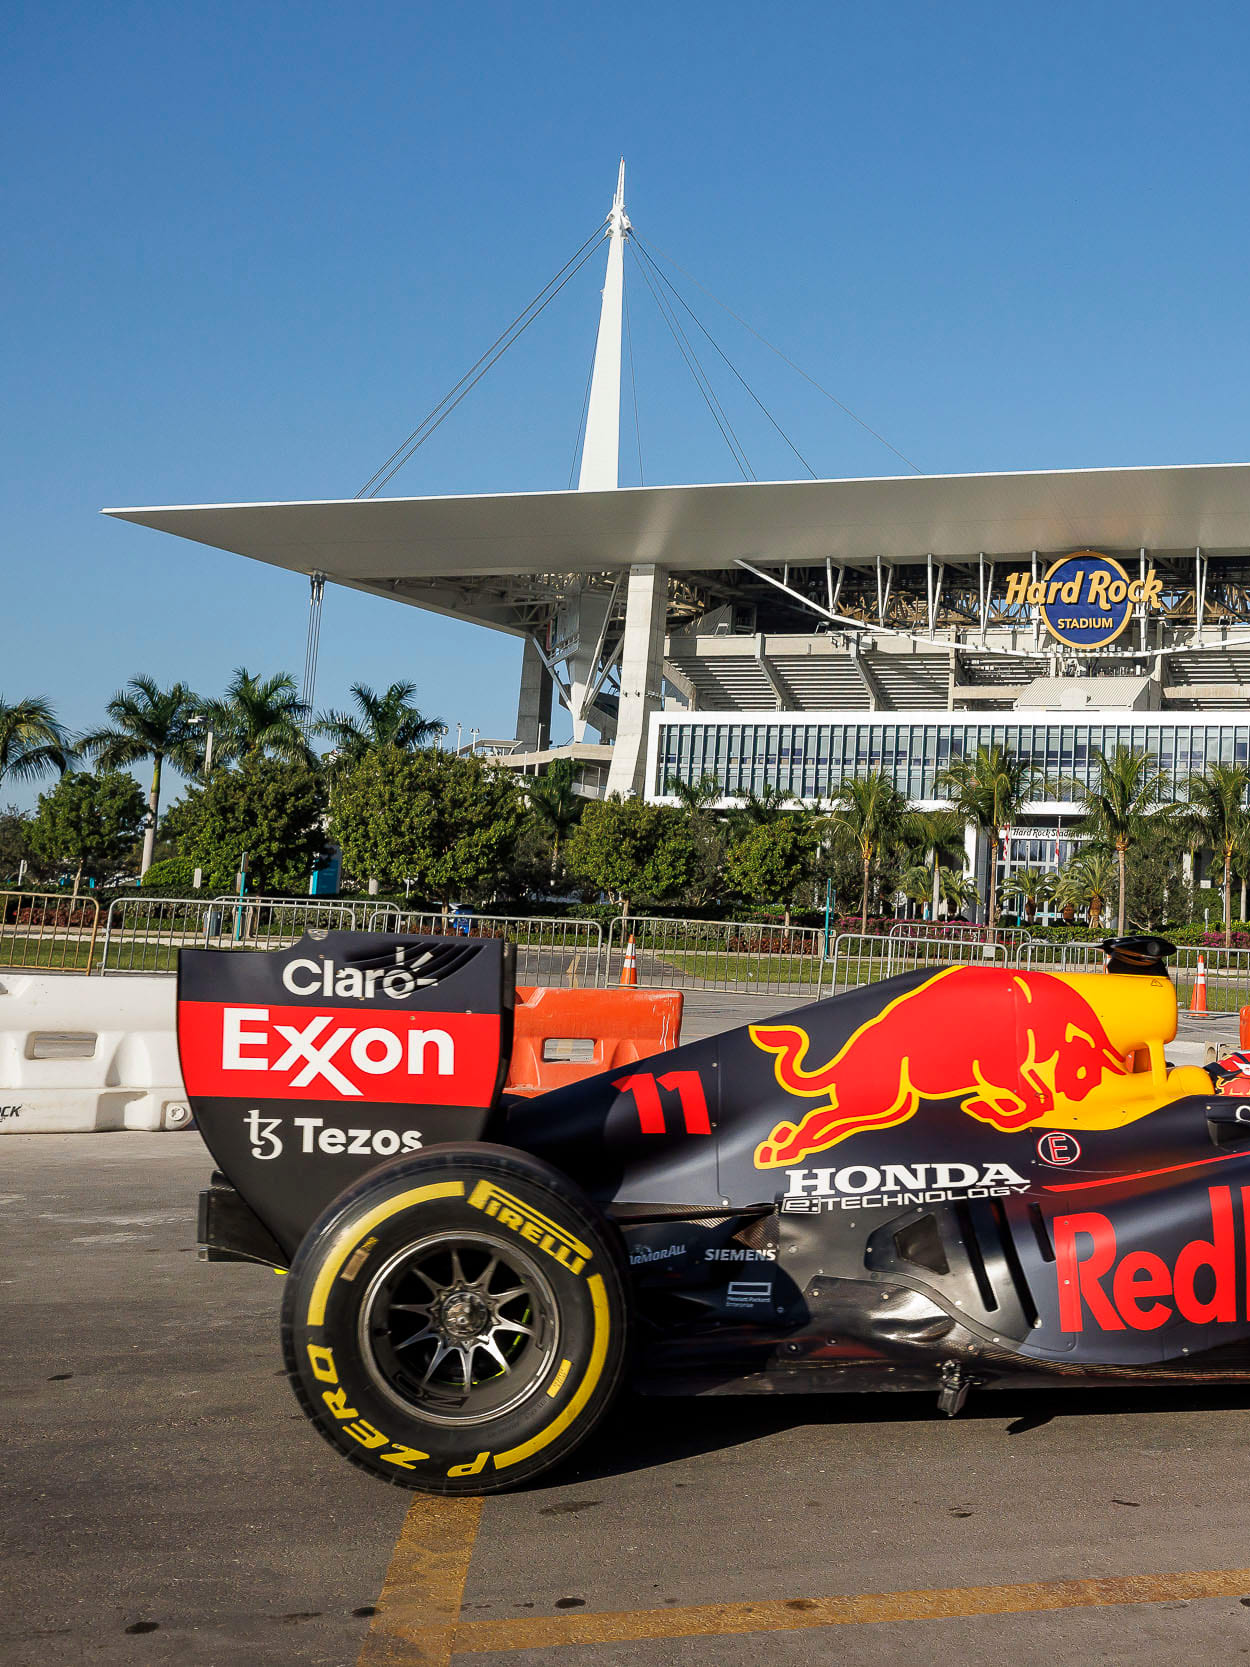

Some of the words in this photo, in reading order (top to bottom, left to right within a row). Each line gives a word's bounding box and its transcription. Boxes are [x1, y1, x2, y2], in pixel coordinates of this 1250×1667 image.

[1005, 571, 1084, 605] Hard
[1088, 569, 1163, 611] Rock
[1058, 617, 1113, 629] STADIUM
[1013, 828, 1031, 837] Hard
[1032, 828, 1051, 839] Rock
[283, 957, 417, 999] Claro
[222, 1008, 455, 1096] Exxon
[611, 1070, 712, 1135] 11
[294, 1117, 423, 1155] Tezos
[783, 1163, 1031, 1198] HONDA
[467, 1179, 594, 1276] PIRELLI
[704, 1248, 776, 1261] SIEMENS
[307, 1343, 431, 1470] ZERO
[447, 1451, 491, 1478] P
